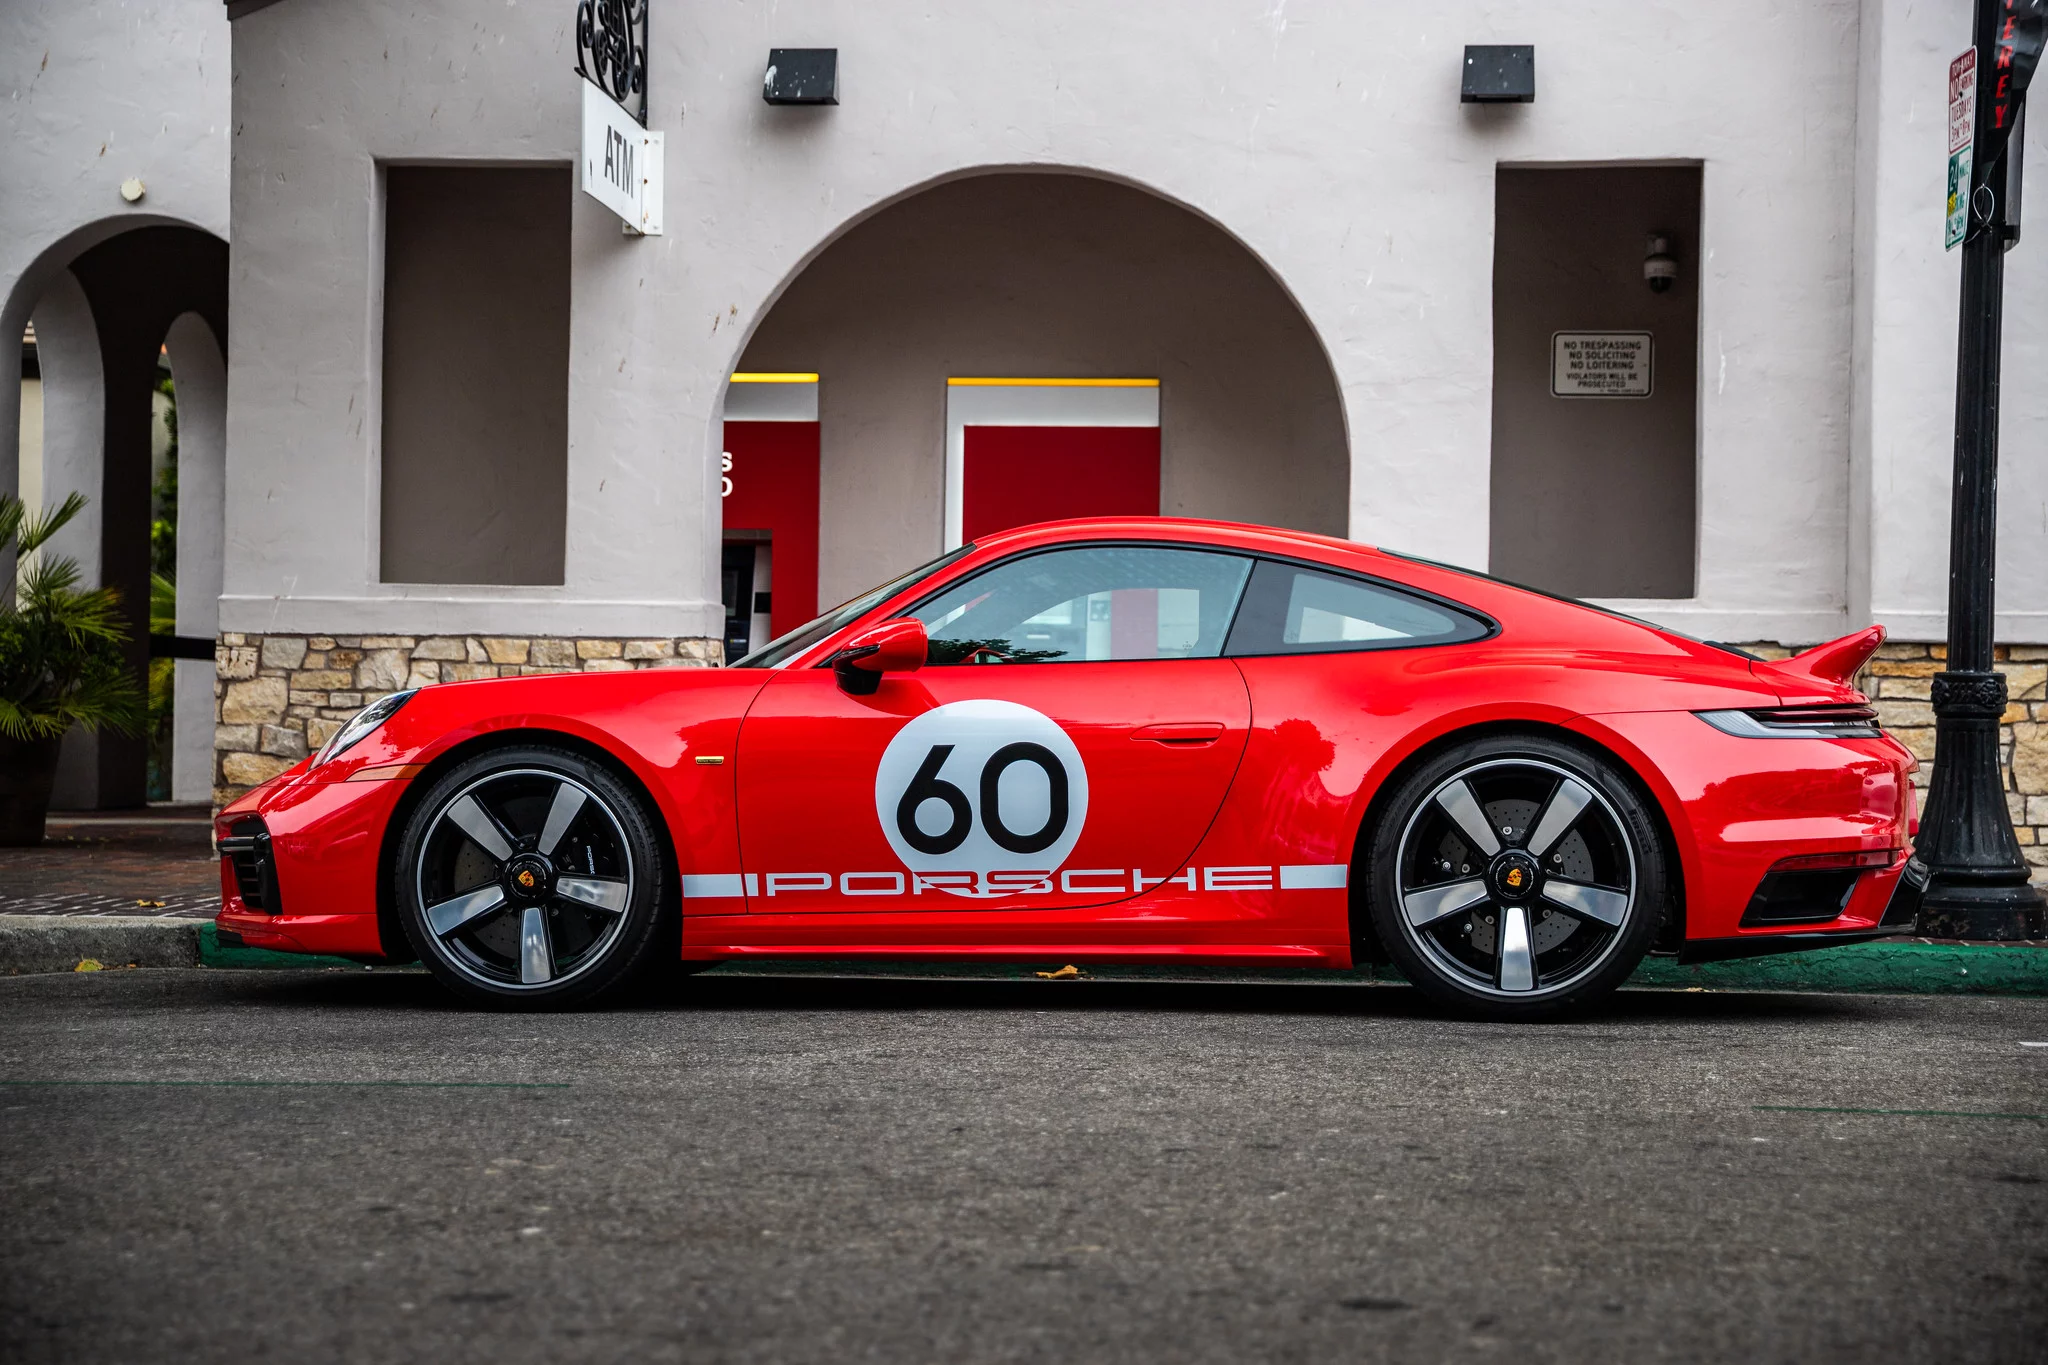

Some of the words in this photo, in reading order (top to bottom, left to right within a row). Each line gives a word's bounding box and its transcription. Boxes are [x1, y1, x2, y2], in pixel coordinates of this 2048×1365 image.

[1950, 77, 1959, 102] NO
[1951, 95, 1971, 123] TUESDAYS
[604, 124, 634, 199] ATM
[1564, 341, 1577, 350] NO
[1580, 341, 1642, 350] TRESPASSING
[1569, 351, 1582, 360] NO
[1585, 351, 1636, 360] SOLICITING
[1570, 361, 1584, 370] NO
[1586, 361, 1635, 370] LOITERING
[1577, 380, 1627, 388] PROSECUTED
[896, 741, 1070, 855] 60
[765, 865, 1273, 897] PORSCHE
